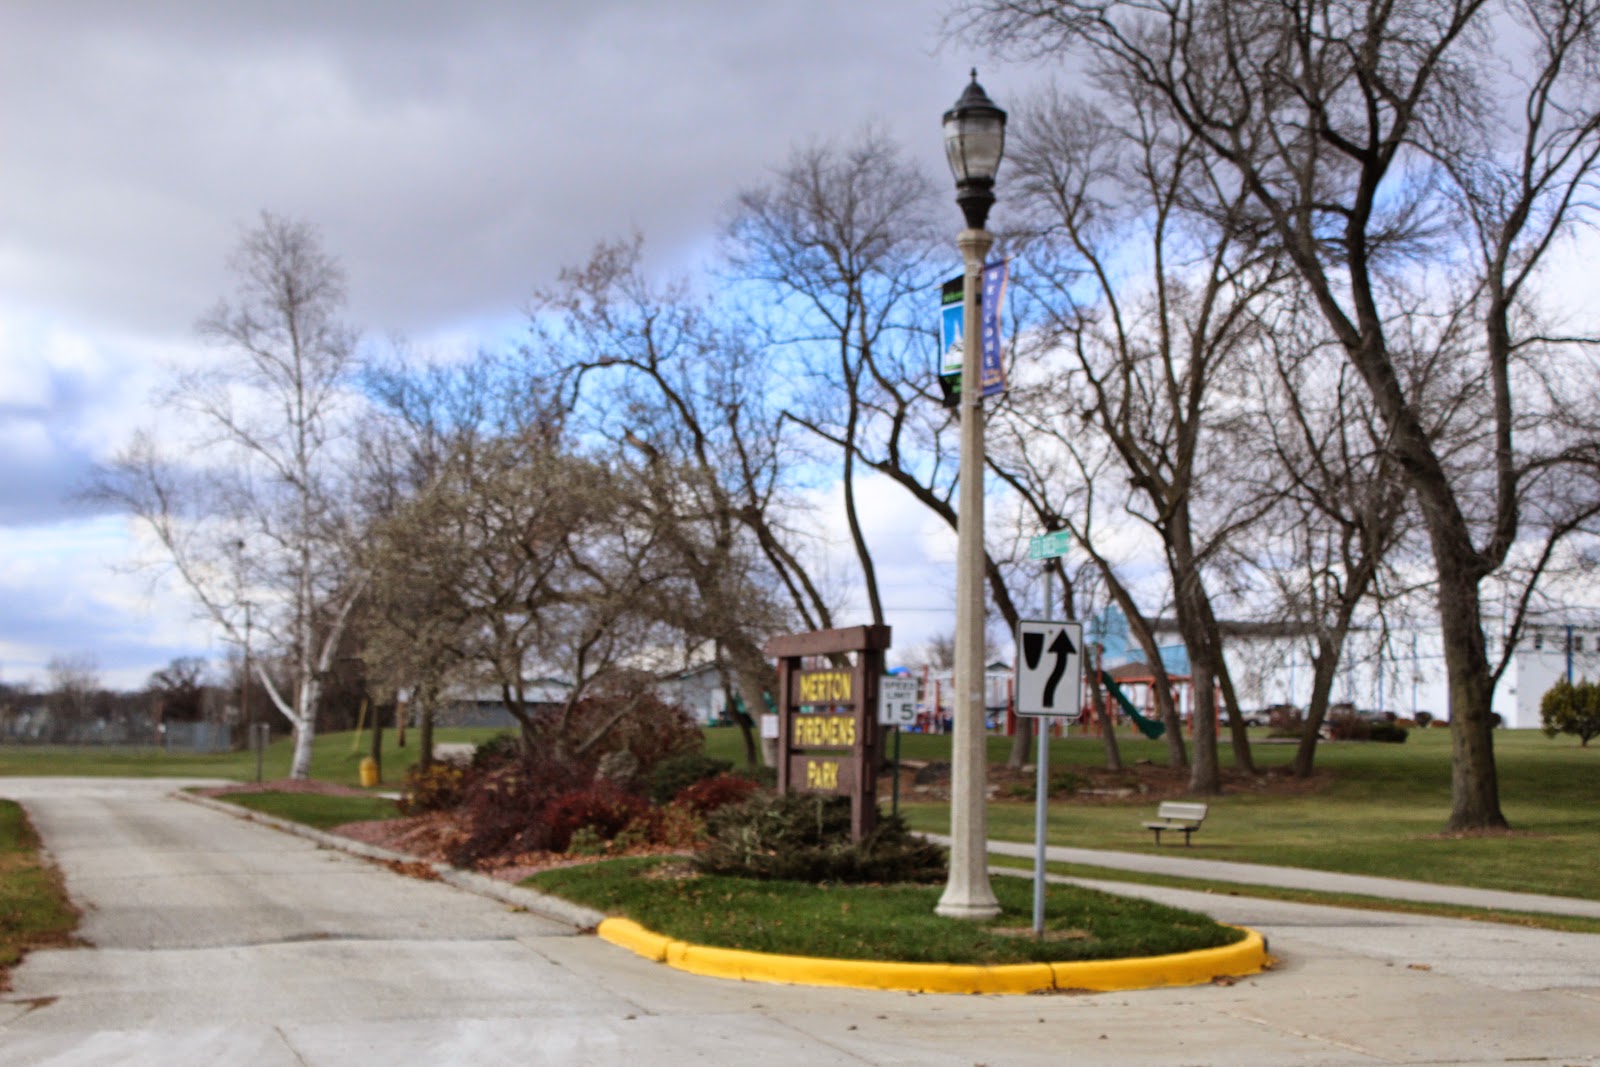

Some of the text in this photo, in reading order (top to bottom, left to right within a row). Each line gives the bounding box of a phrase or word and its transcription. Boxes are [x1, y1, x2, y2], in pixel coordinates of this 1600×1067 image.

[984, 271, 999, 367] WELCOME
[800, 673, 852, 702] MERTON
[884, 681, 915, 691] SPEED
[886, 692, 912, 700] LIMIT
[885, 703, 914, 721] 15
[794, 717, 856, 746] FIREMENS
[807, 760, 840, 789] PARK
